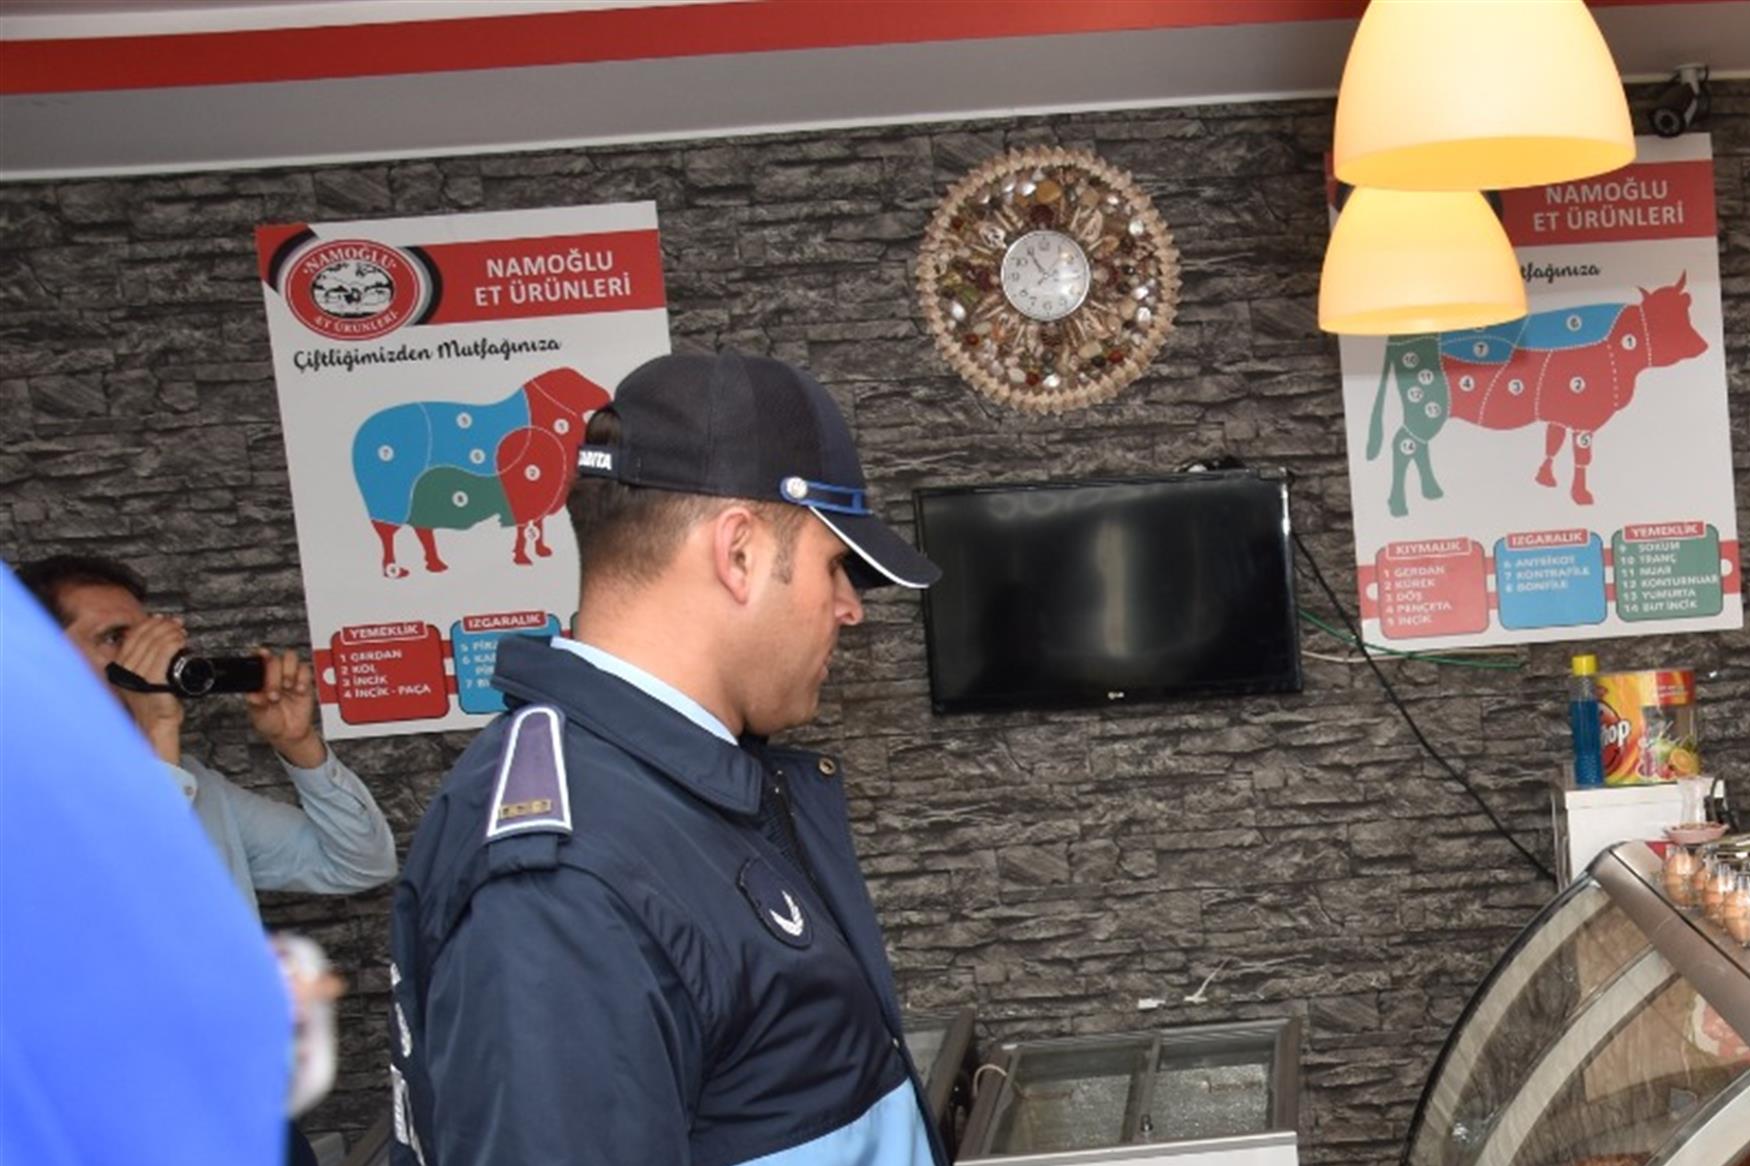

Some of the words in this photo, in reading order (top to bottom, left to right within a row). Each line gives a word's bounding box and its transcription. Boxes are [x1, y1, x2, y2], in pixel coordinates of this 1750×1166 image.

[1545, 177, 1668, 204] NAMOĞLU
[1533, 212, 1559, 232] ET
[1567, 201, 1684, 231] ÜRÜNLERİ
[304, 244, 395, 275] NAMOĞLU
[486, 248, 613, 278] NAMOĞLU
[475, 286, 502, 306] ET
[510, 272, 631, 304] ÜRÜNLERİ
[293, 344, 431, 373] Çiftliğimizden
[438, 337, 560, 363] Mutfağınıza
[350, 622, 418, 639] YEMEKLİK
[467, 613, 541, 629] IZGARALIK
